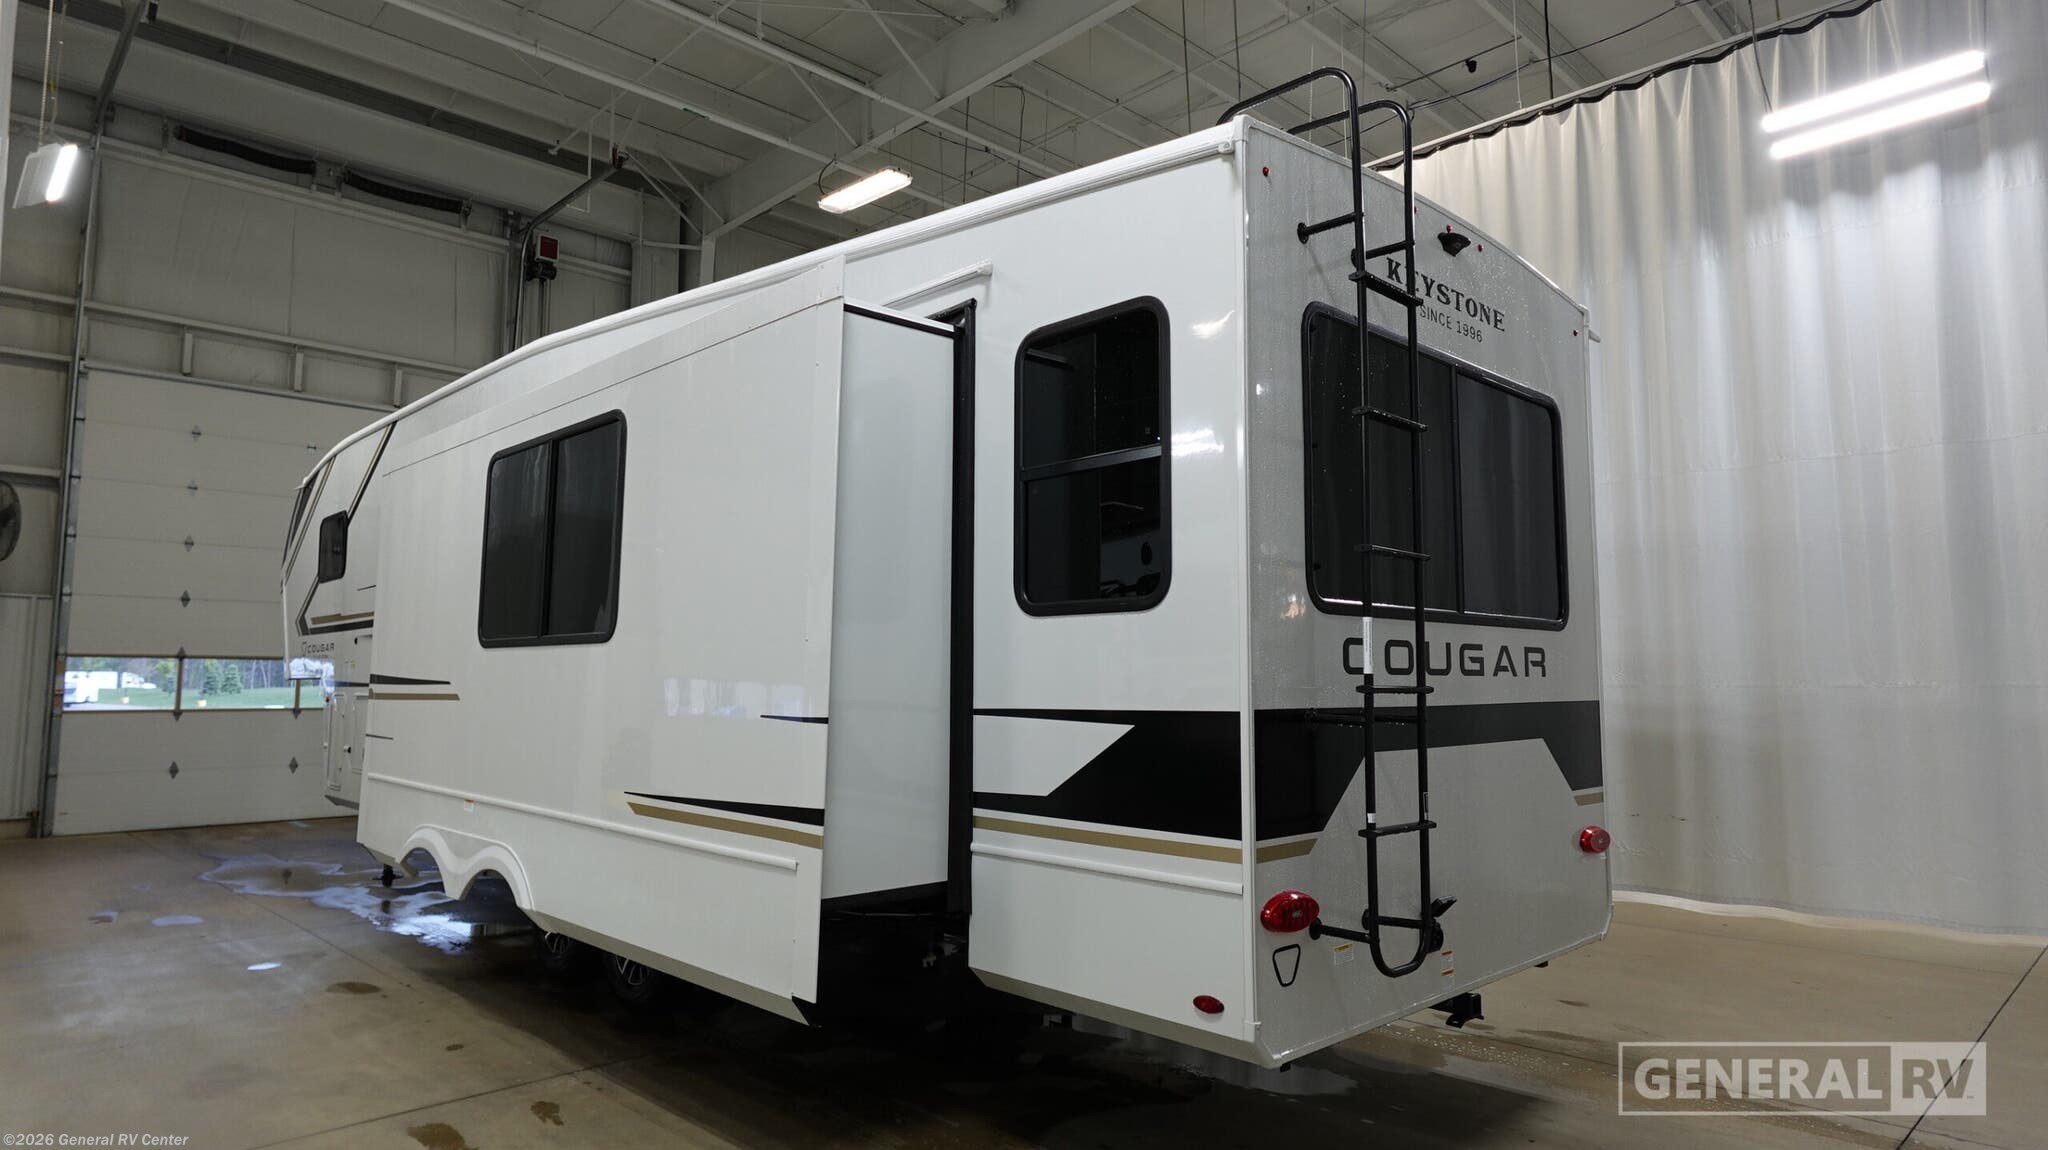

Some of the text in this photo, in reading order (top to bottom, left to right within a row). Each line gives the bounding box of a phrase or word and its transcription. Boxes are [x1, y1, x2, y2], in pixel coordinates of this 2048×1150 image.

[1386, 257, 1505, 332] KYSTONE
[1420, 305, 1483, 343] SINCE 1996
[307, 642, 335, 654] COUGAR
[1342, 637, 1547, 678] COUGAR
